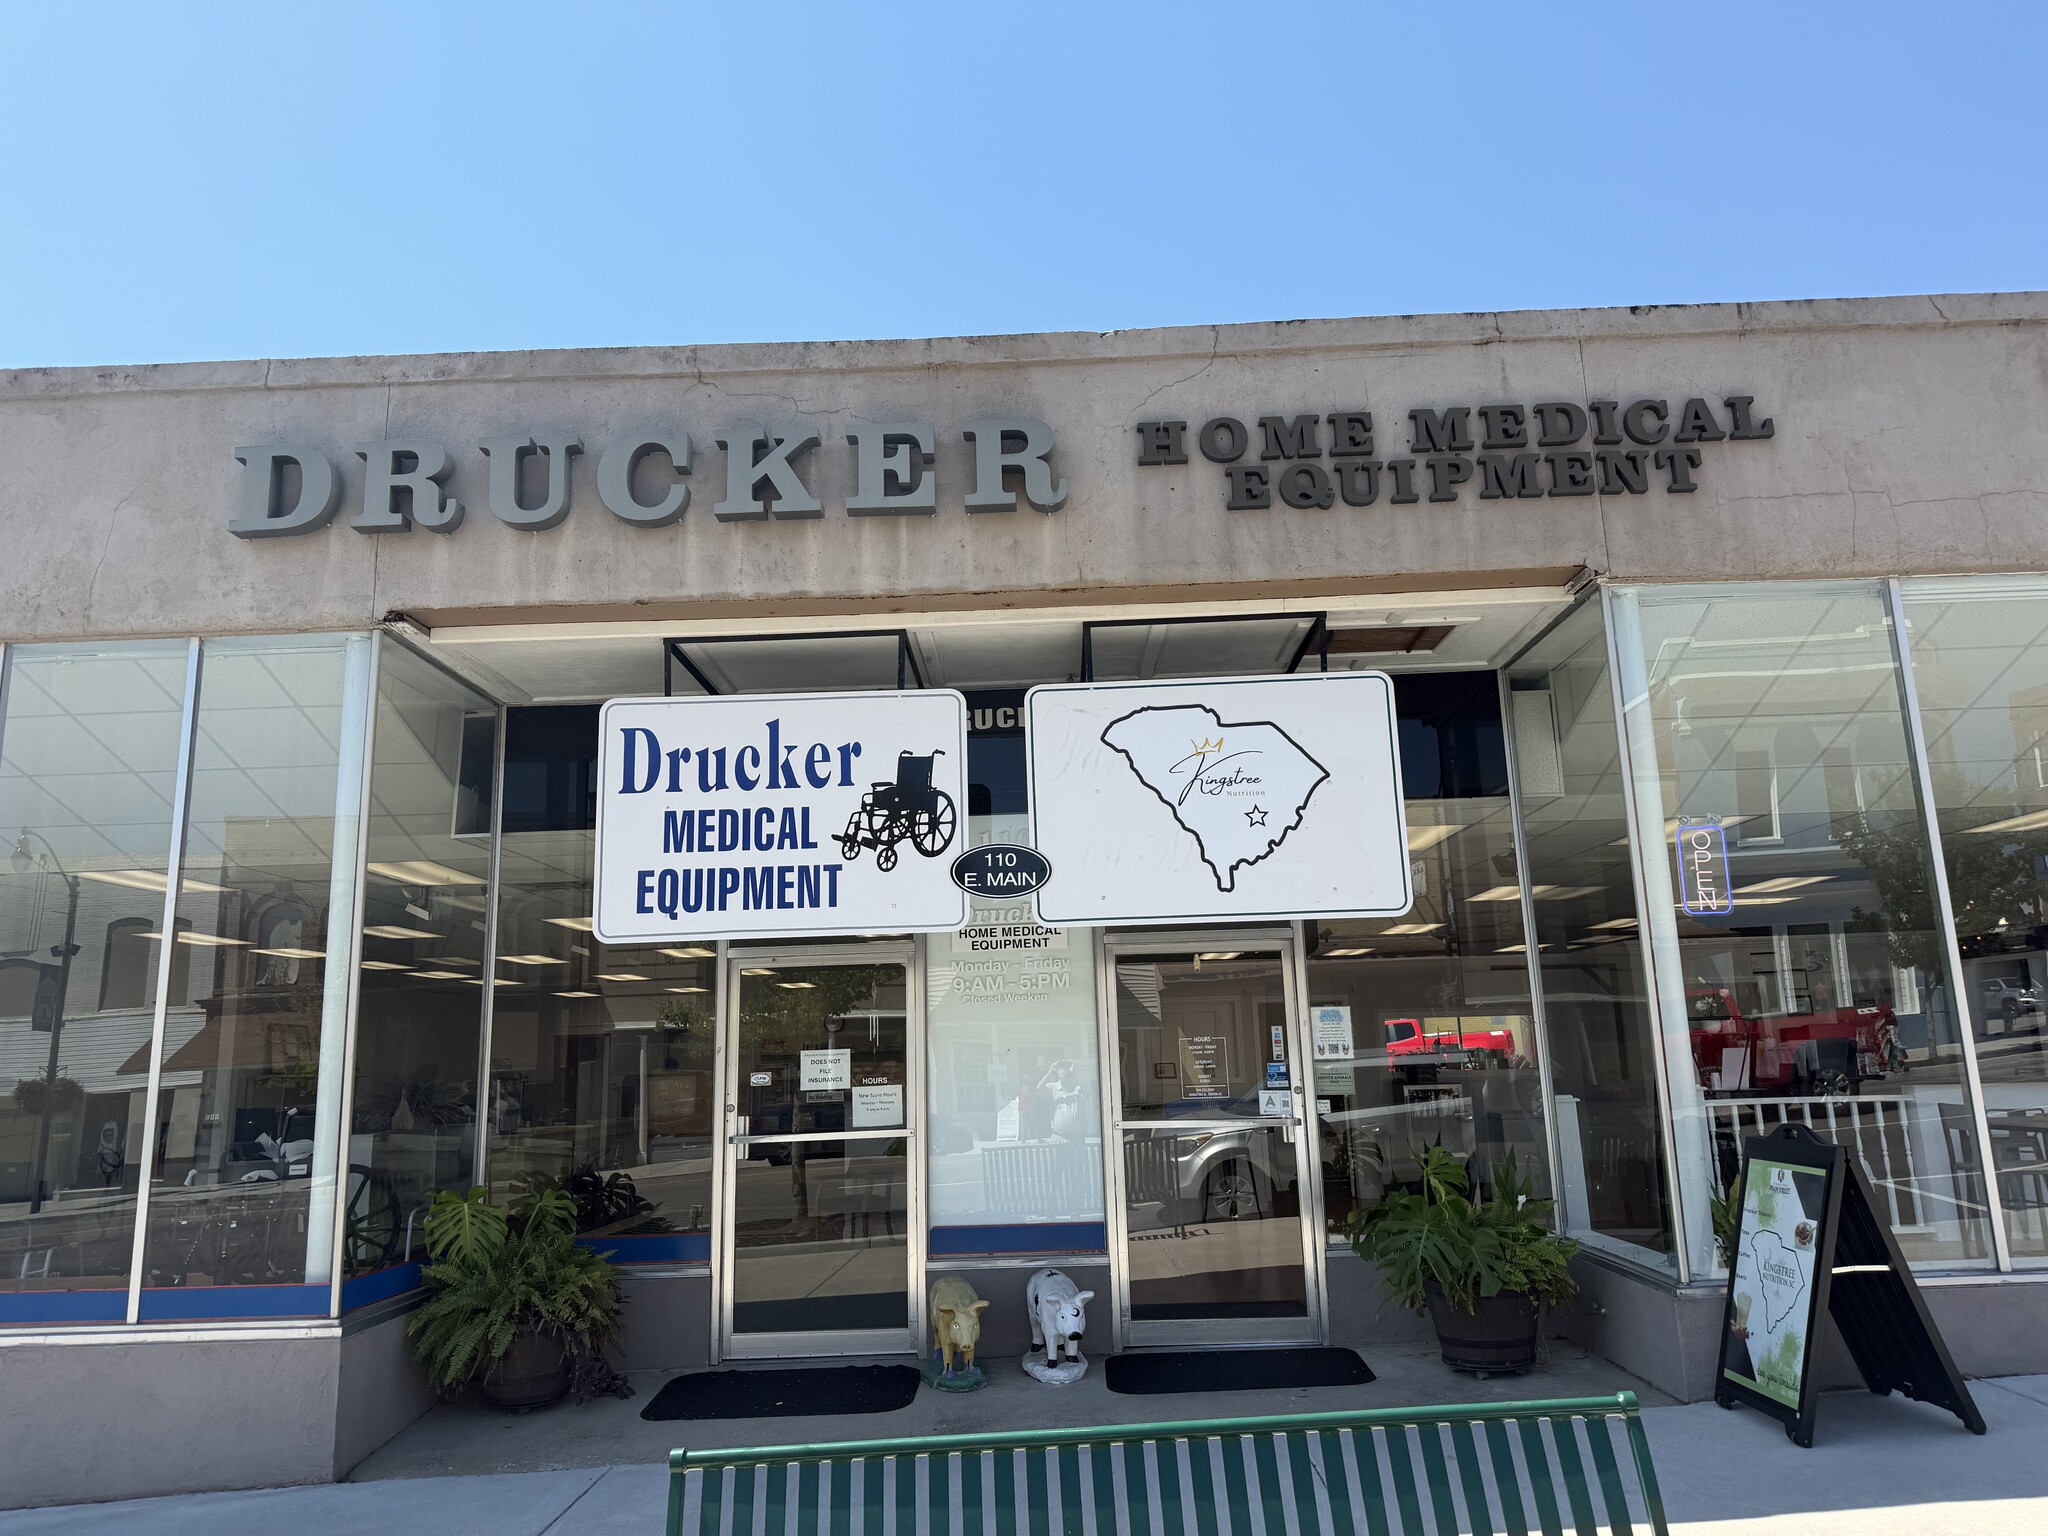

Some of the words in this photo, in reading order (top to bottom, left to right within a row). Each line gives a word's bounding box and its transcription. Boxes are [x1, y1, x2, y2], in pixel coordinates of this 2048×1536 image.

[1137, 411, 1374, 466] HOME
[1408, 396, 1774, 454] MEDICAL
[227, 418, 1069, 538] DRUCKER
[1225, 448, 1702, 510] EQUIPMENT
[618, 718, 862, 795] Drucker
[1169, 750, 1263, 806] Kingstree
[1226, 789, 1266, 797] Nutrition
[663, 806, 818, 854] MEDICAL
[984, 853, 1017, 867] 110
[1692, 831, 1717, 910] OPEN
[964, 873, 981, 886] E.
[987, 872, 1036, 886] MAIN
[636, 863, 843, 920] EQUIPMENT
[959, 928, 998, 939] HOME
[1002, 926, 1062, 938] MEDICAL
[971, 938, 1050, 951] EQUIPMENT
[951, 960, 1010, 973] Monday
[1024, 957, 1071, 971] Friday
[952, 975, 1004, 993] 9:AM
[1019, 972, 1070, 990] 5:PM
[962, 994, 1001, 1004] Closed
[1763, 1261, 1796, 1279] KINGSTREE
